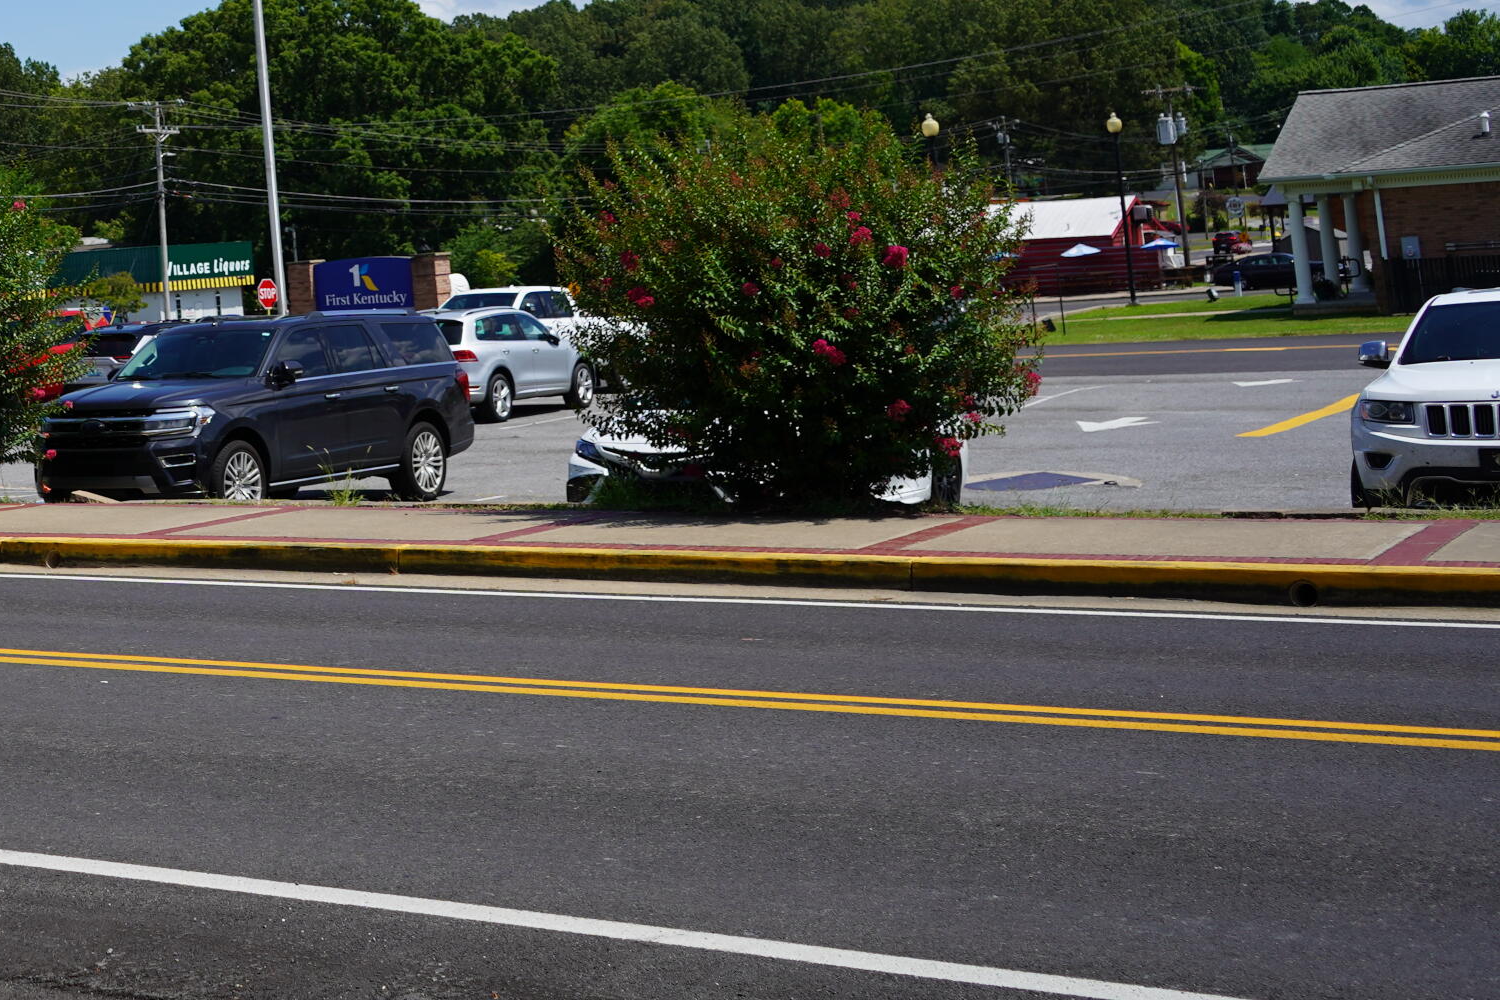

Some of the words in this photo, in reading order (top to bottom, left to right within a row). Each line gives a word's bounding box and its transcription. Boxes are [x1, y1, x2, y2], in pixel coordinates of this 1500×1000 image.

[213, 257, 250, 275] Liquors
[259, 287, 277, 300] STOP
[325, 294, 351, 307] First
[353, 290, 407, 306] Kentucky
